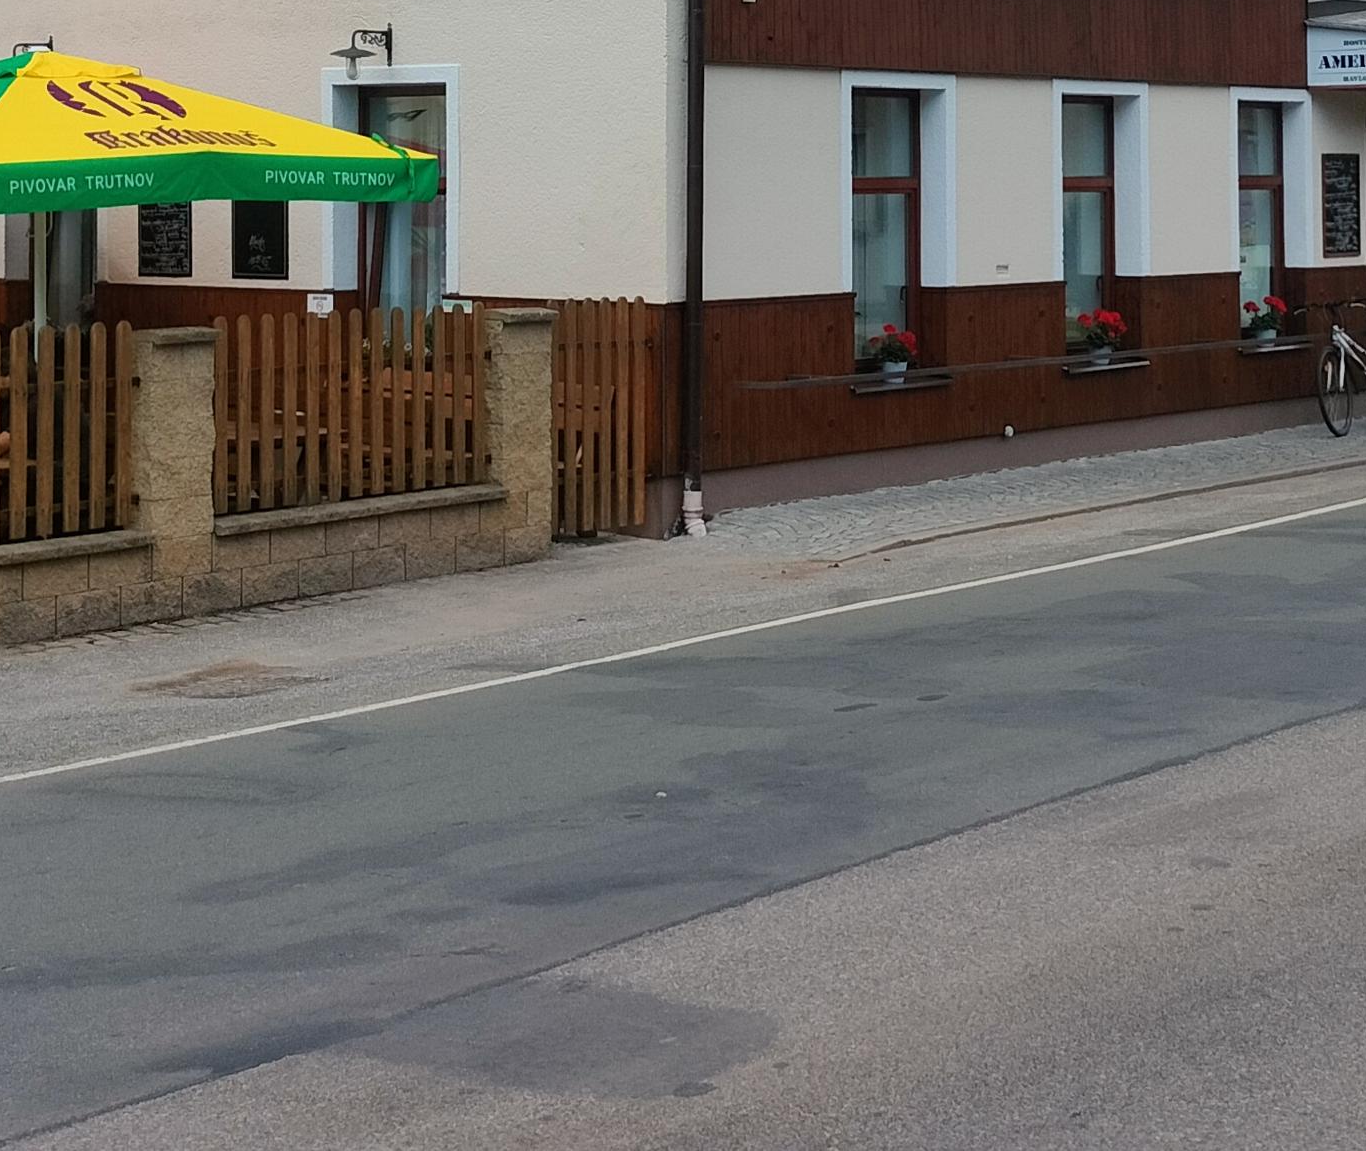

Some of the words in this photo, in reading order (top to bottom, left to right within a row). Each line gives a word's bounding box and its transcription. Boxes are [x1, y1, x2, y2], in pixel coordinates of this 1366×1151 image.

[9, 176, 77, 195] PIVOVAR
[85, 171, 155, 191] TRUTNOV
[265, 169, 325, 185] PIVOVAR
[333, 171, 395, 186] TRUTNOV
